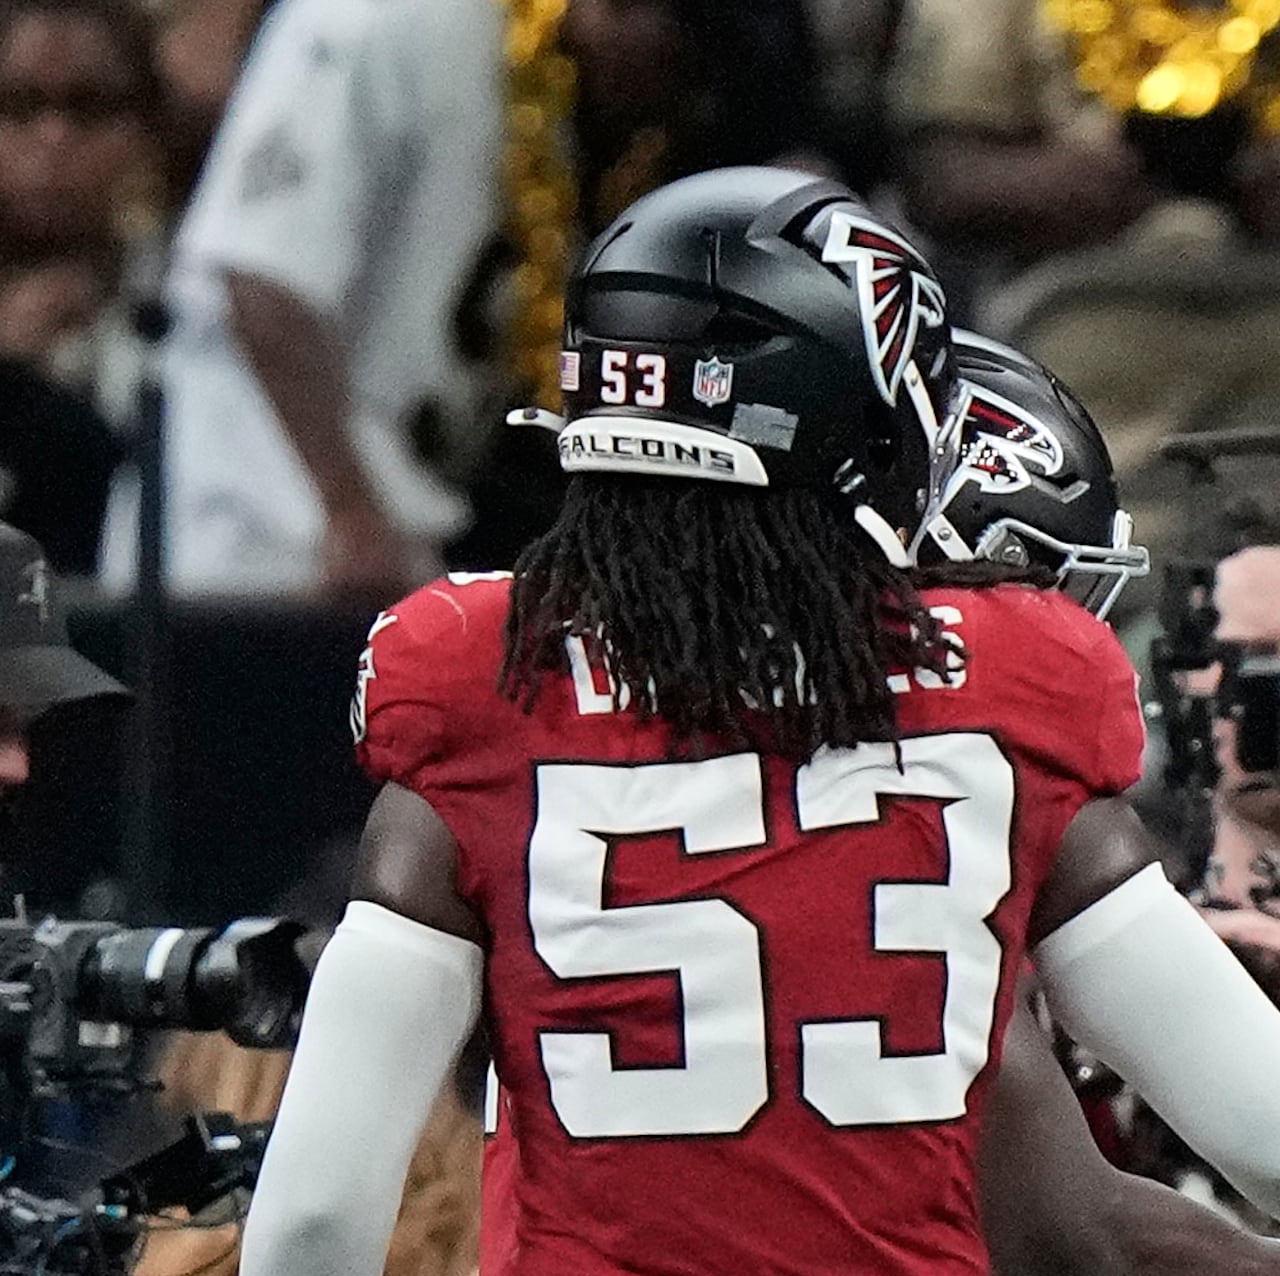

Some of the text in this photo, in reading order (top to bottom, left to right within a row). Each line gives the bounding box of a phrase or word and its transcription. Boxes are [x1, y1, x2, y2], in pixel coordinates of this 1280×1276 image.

[600, 350, 666, 407] 53
[559, 434, 736, 475] FALCONS
[528, 733, 1015, 1138] 53
